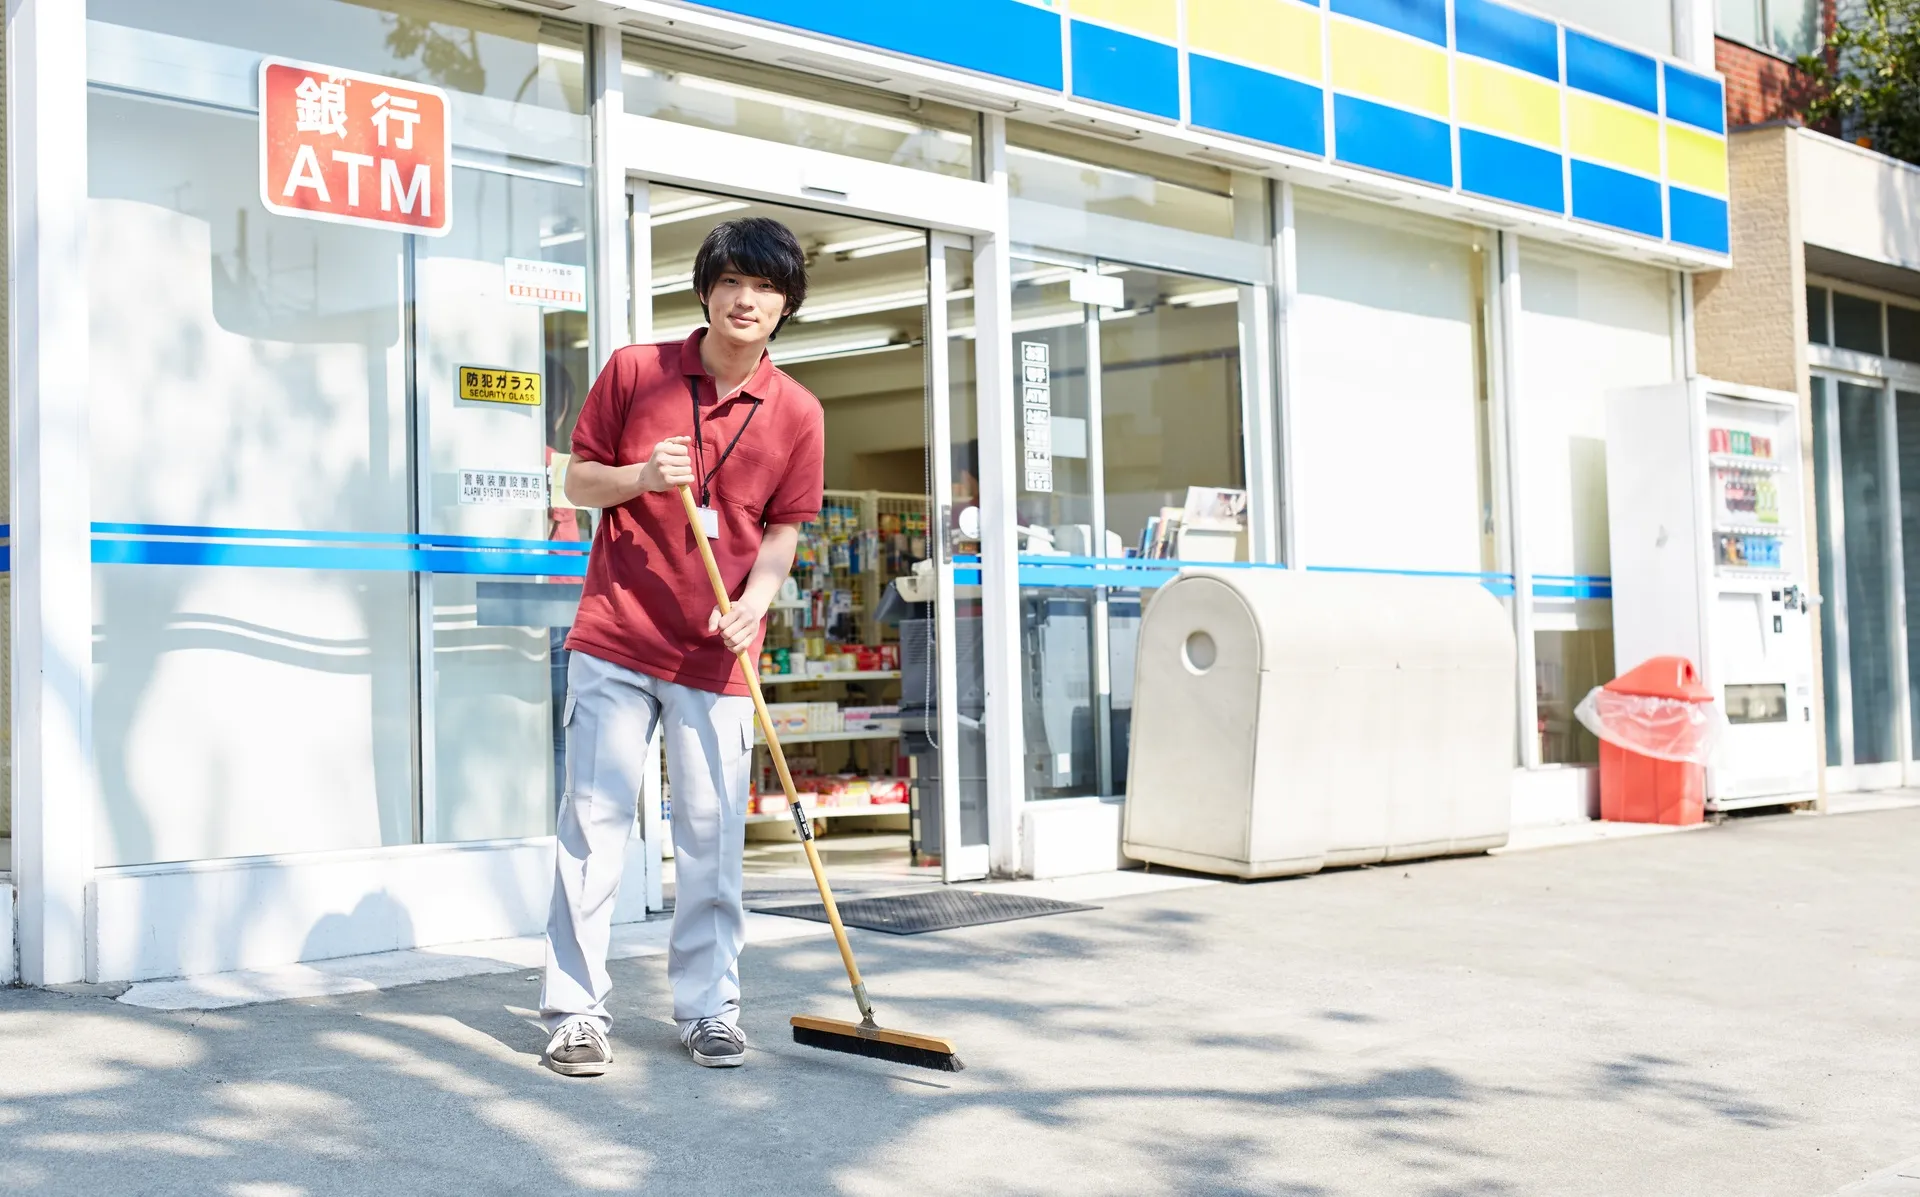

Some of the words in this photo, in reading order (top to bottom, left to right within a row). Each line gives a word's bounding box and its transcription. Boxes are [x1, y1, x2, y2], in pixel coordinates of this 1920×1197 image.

[295, 76, 421, 150] 銀行
[282, 144, 431, 217] ATM
[466, 372, 535, 391] 防犯ガラス
[469, 388, 506, 400] SECURITY
[508, 392, 535, 402] GLASS
[1026, 388, 1048, 404] ATM
[464, 473, 540, 489] 警報装置設置店
[464, 486, 481, 497] ALARM
[483, 487, 504, 498] SYSTEM
[512, 489, 540, 500] OPERATION
